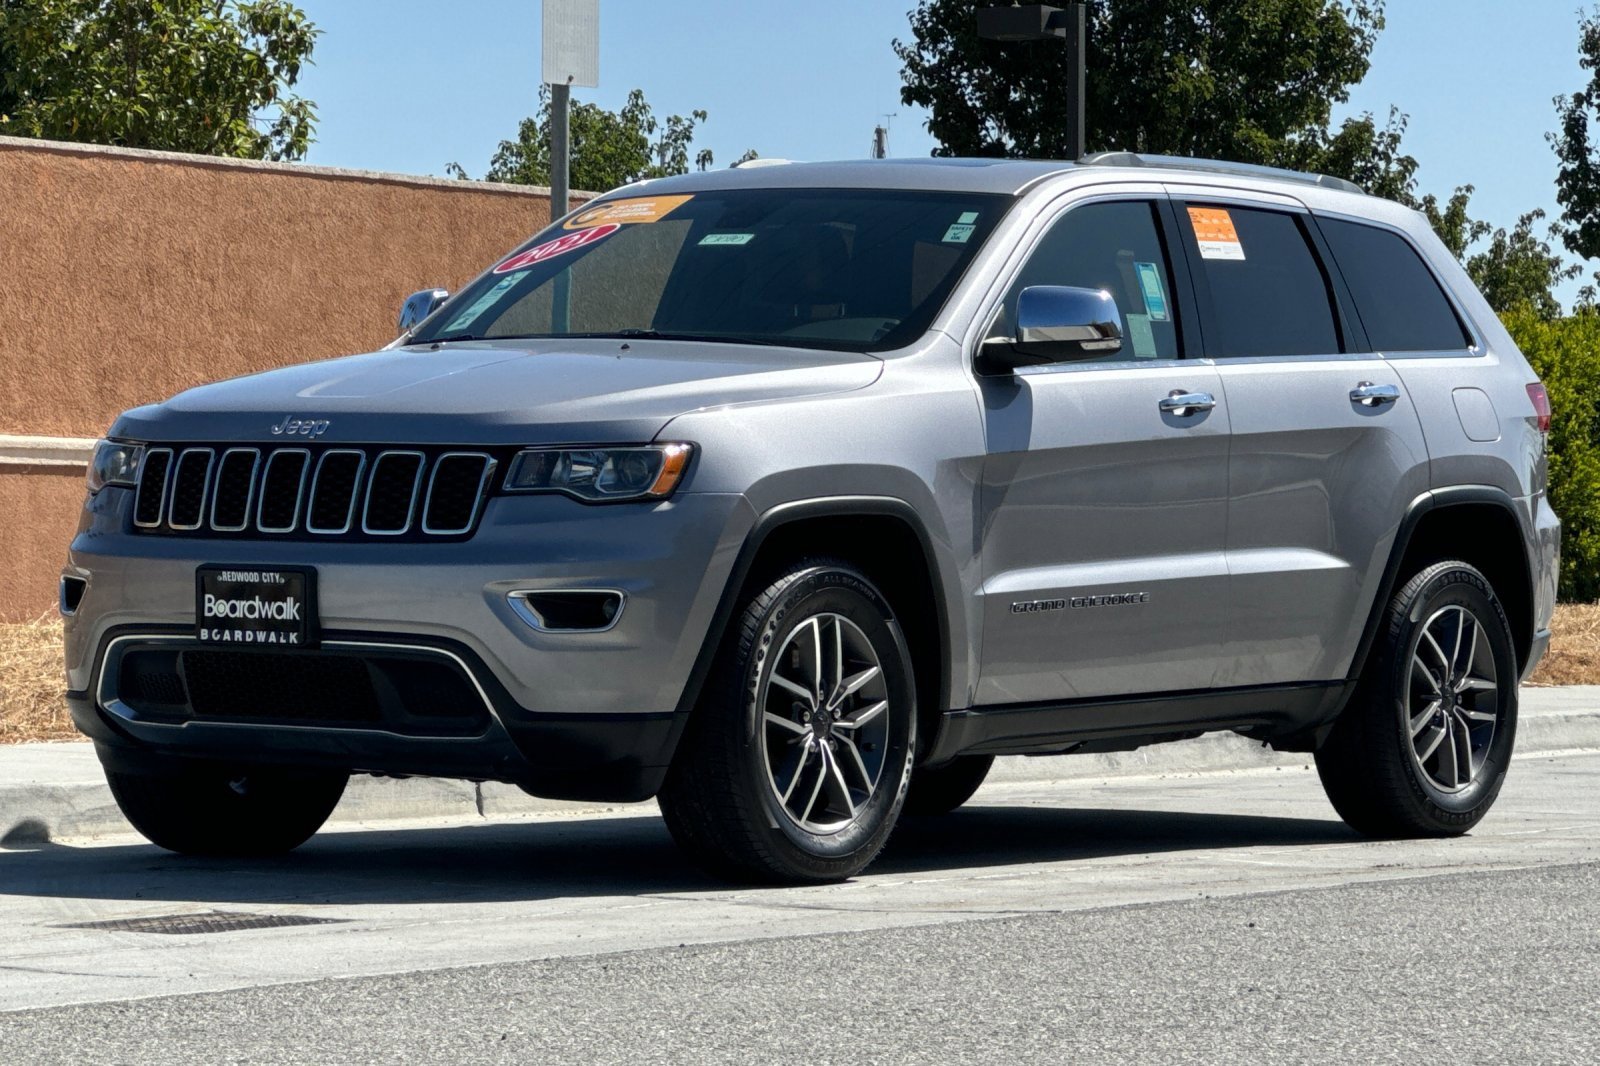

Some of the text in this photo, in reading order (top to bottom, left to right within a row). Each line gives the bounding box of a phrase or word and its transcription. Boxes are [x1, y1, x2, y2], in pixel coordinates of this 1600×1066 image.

[510, 227, 600, 269] 2021
[271, 415, 330, 439] Jeep
[222, 571, 280, 583] REDWOOD CITY
[204, 594, 301, 620] Boardwalk
[1010, 592, 1149, 614] GRAND CHEROKEE
[200, 628, 298, 644] BOARDWALK
